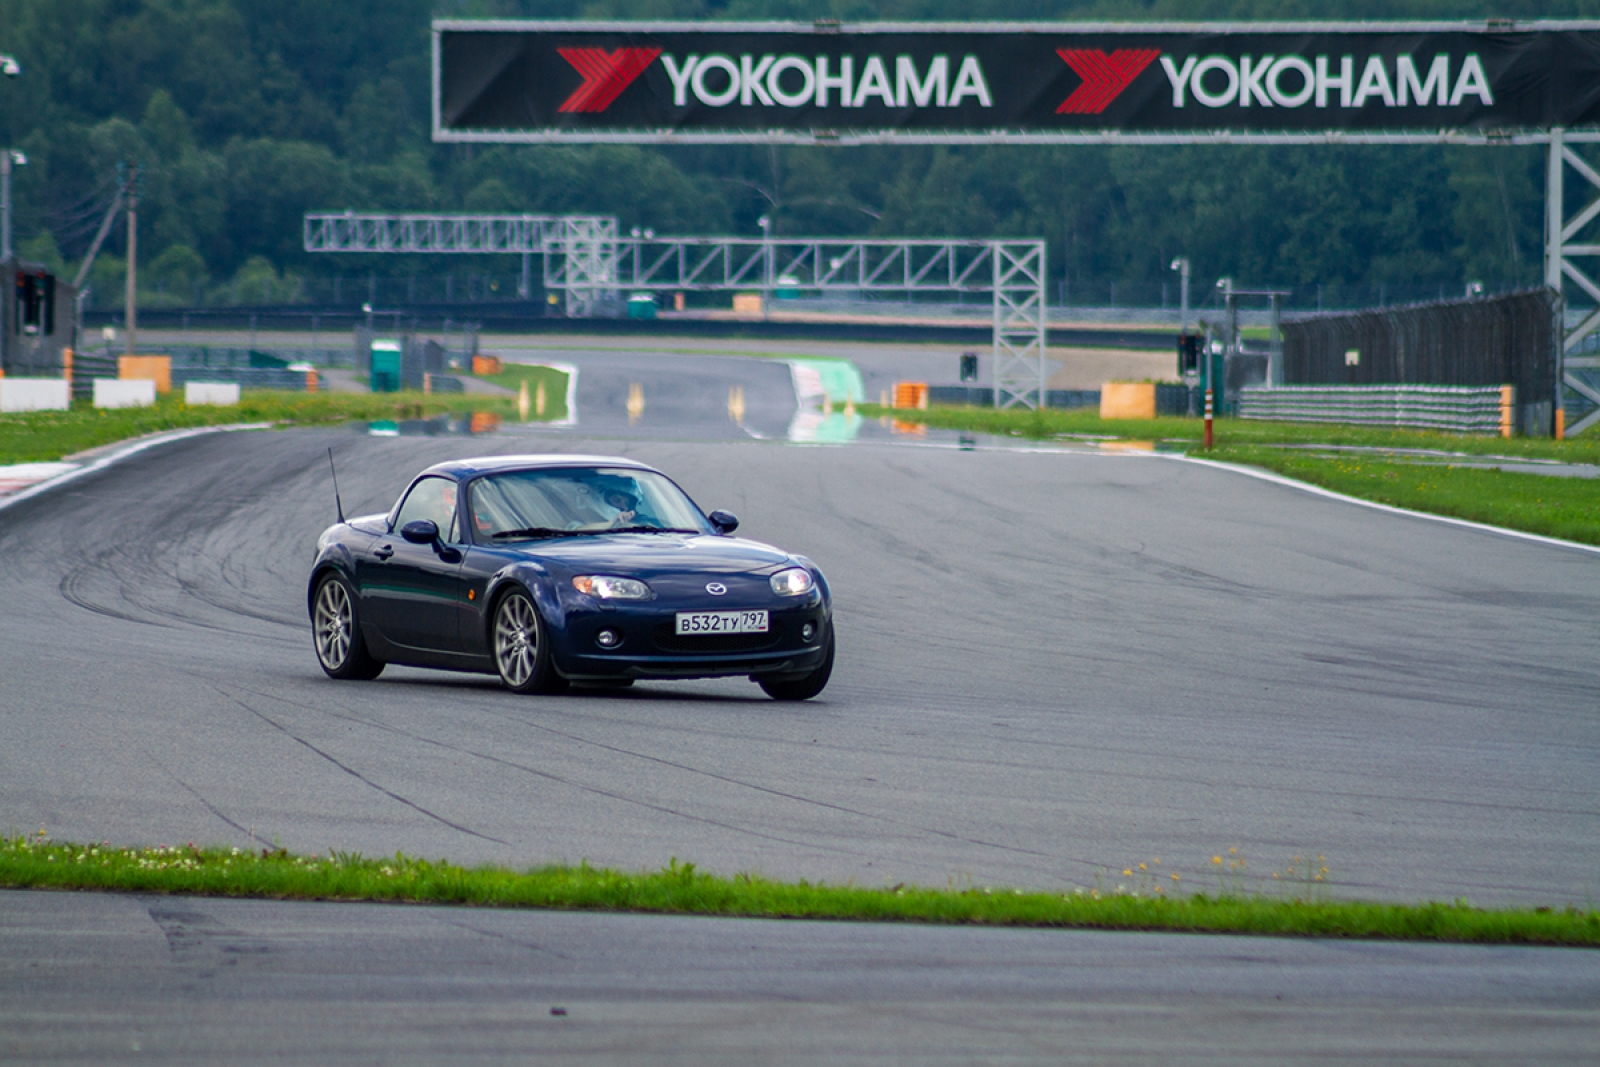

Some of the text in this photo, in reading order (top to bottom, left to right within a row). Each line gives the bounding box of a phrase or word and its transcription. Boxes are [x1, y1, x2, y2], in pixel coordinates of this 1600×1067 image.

[661, 55, 992, 108] YOKOHAMA
[1160, 54, 1493, 108] YOKOHAMA
[742, 612, 764, 625] 797
